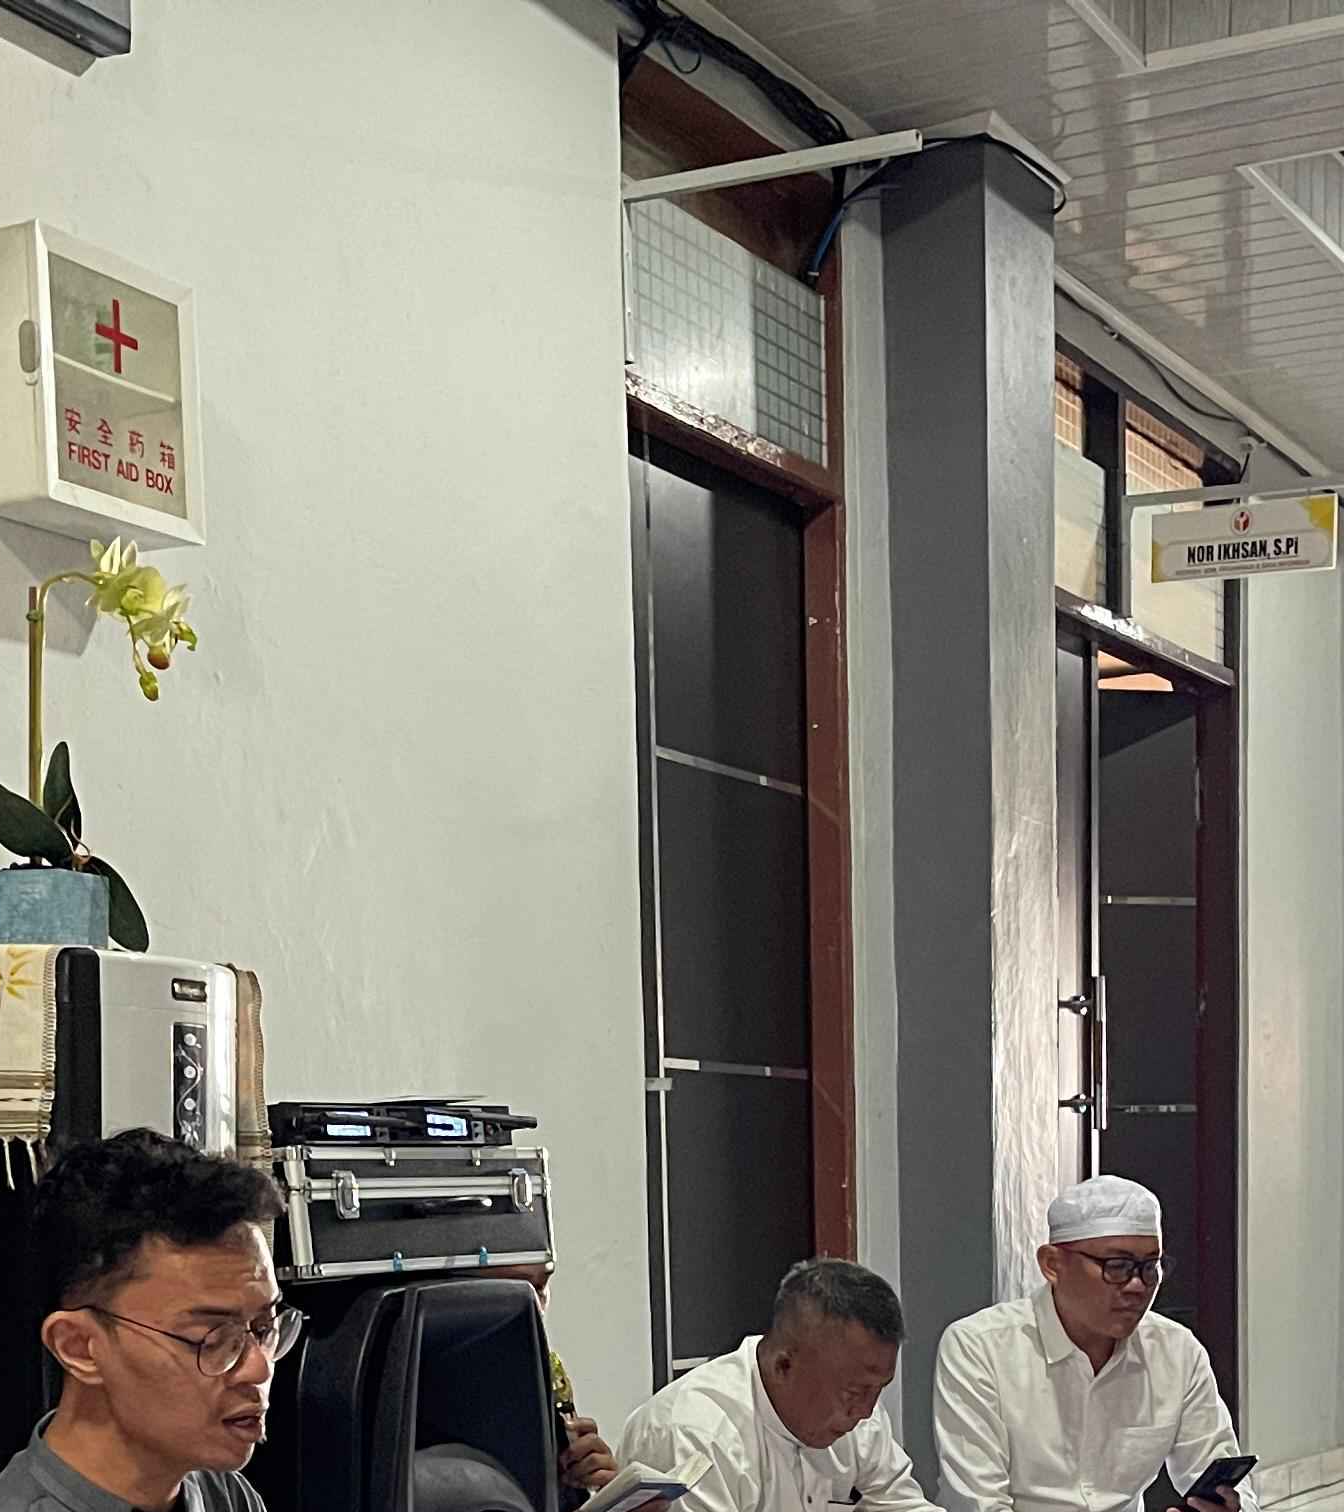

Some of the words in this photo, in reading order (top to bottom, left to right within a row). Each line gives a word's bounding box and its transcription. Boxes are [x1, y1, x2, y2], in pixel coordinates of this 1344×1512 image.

[67, 441, 111, 472] FIRST
[116, 458, 140, 482] AID
[145, 467, 174, 496] BOX
[1187, 544, 1214, 564] NOR
[1217, 539, 1271, 561] IKHSAN,
